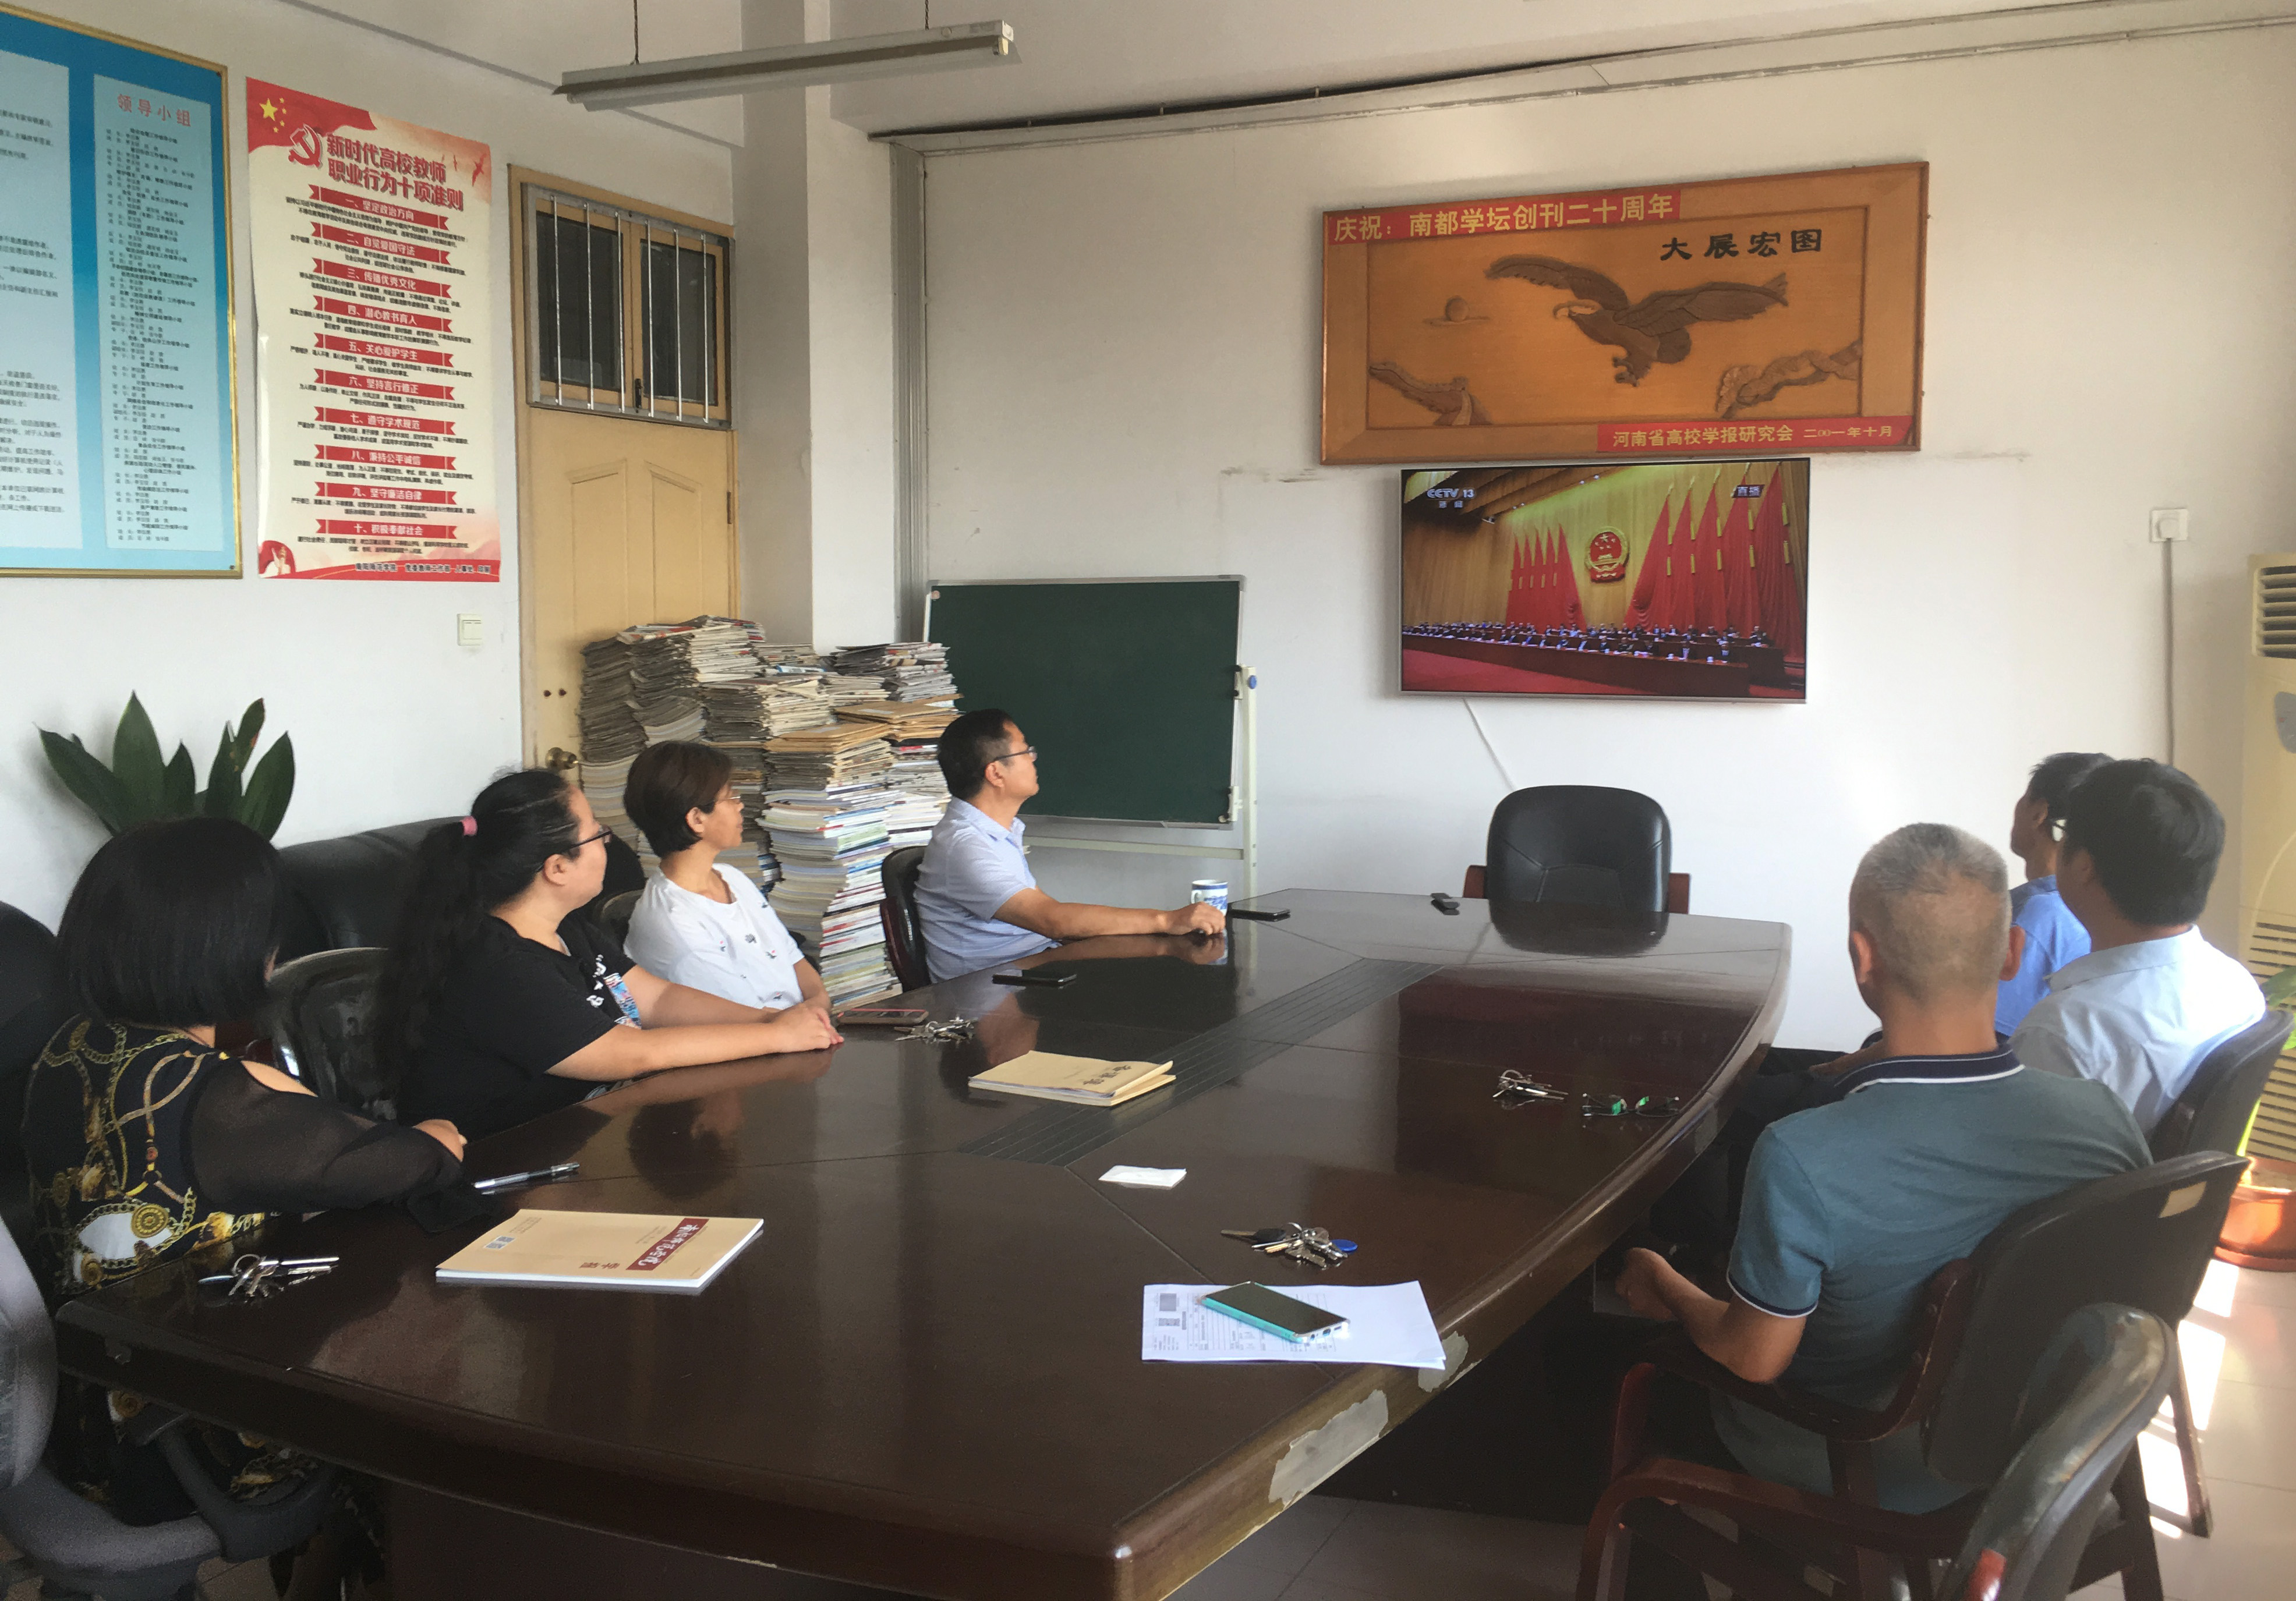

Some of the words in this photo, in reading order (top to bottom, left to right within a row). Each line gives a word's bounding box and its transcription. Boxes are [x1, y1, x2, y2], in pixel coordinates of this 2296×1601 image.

[117, 94, 191, 127] 领导小组
[327, 134, 446, 184] 新时代高校教师
[328, 158, 464, 211] 职业行为十项准则
[345, 199, 415, 221] 一、坚定政治方向
[1409, 193, 1673, 237] 南都学坛创刊二十周年
[1660, 229, 1822, 261] 大展宏图
[1612, 424, 1793, 447] 河南省高校学报研究会
[1427, 488, 1460, 498] CCTV
[1463, 489, 1474, 498] 13
[1737, 486, 1760, 496] 直播
